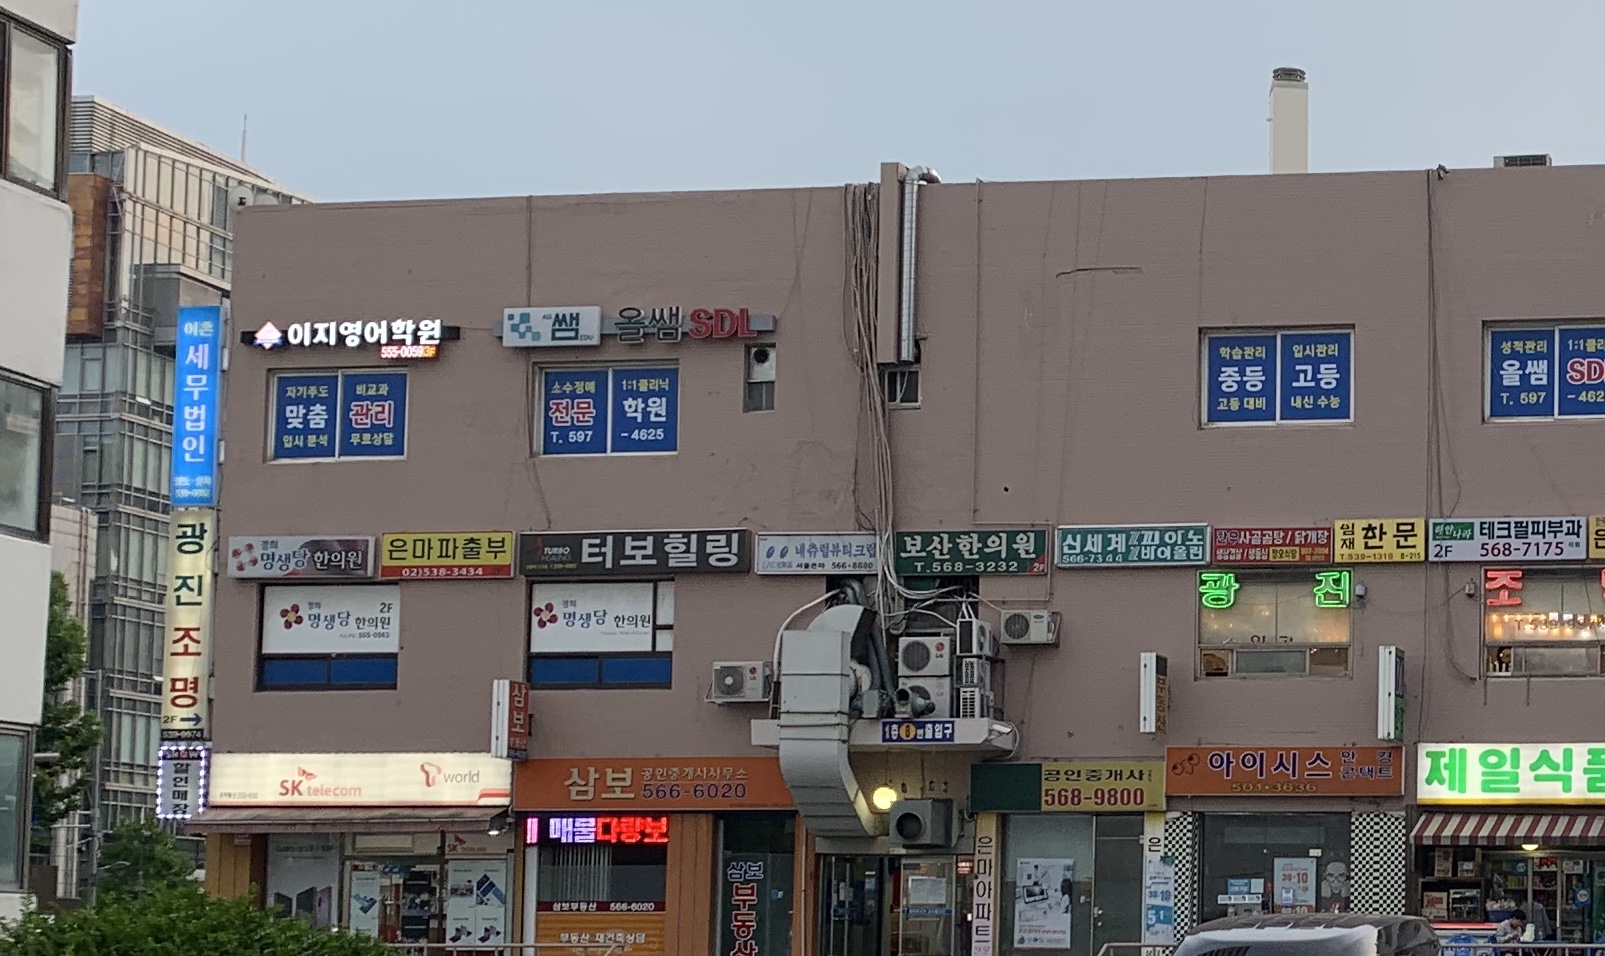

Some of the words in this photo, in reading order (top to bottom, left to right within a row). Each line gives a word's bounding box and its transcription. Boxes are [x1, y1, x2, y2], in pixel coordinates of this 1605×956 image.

[551, 312, 579, 341] 쌤
[613, 306, 682, 344] 올쌤
[687, 307, 757, 341] SDL
[287, 319, 442, 347] 이지영어학원
[381, 345, 423, 359] 555-0059
[1218, 346, 1267, 360] 학습관리
[1292, 343, 1339, 358] 입시관리
[1500, 339, 1548, 354] 성적관리
[1217, 365, 1267, 393] 중등
[1291, 363, 1341, 390] 고등
[1499, 359, 1549, 386] 올쌤
[285, 386, 329, 398] 자기주도
[355, 384, 389, 396] 비교과
[551, 381, 596, 394] 소수정예
[621, 378, 670, 392] 1:1클리닉
[181, 343, 210, 463] 세무법인
[1216, 398, 1241, 411] 고등
[1243, 397, 1267, 411] 대비
[1290, 395, 1315, 409] 내신
[1316, 394, 1341, 408] 수능
[1500, 393, 1514, 405] T.
[1520, 391, 1547, 405] 597
[284, 404, 329, 430] 맞춤
[349, 401, 394, 428] 관리
[548, 398, 597, 426] 전문
[622, 397, 668, 423] 학원
[283, 434, 304, 448] 입시
[307, 434, 329, 447] 분석
[349, 432, 394, 446] 무료상담
[550, 431, 563, 444] T.
[568, 431, 593, 443] 597
[1140, 530, 1204, 546] 피아노
[1361, 522, 1418, 551] 한문
[1479, 520, 1583, 540] 테크필피부과
[387, 537, 506, 560] 은마파출부
[544, 546, 570, 555] TURBO
[581, 533, 739, 569] 터보힐링
[899, 532, 1038, 560] 보산한의원
[1062, 532, 1126, 555] 신세계
[1433, 544, 1453, 559] 2F
[1480, 541, 1564, 558] 568-7175
[260, 549, 310, 571] 명생당
[313, 550, 363, 569] 한의원
[1062, 554, 1124, 564] 566-7344
[1140, 546, 1203, 561] 바이올린
[402, 567, 484, 577] 02)538-3434
[913, 561, 1018, 574] T.568-3232
[1033, 563, 1046, 573] 2F
[1313, 571, 1351, 609] 진
[1485, 570, 1523, 607] 조
[169, 522, 208, 709] 광진조명
[379, 602, 393, 613] 2F
[308, 611, 351, 630] 명생당
[355, 616, 390, 630] 한의원
[563, 609, 607, 629] 명생당
[614, 614, 651, 629] 한의원
[512, 684, 527, 733] 삼보
[162, 715, 178, 724] 2F
[641, 766, 748, 781] 공인중개사사무소
[1208, 750, 1332, 780] 아이시스
[1339, 765, 1393, 781] 콘택트
[443, 770, 480, 785] world
[564, 766, 635, 801] 삼보
[1043, 769, 1145, 782] 공인중개사
[279, 780, 303, 796] SK
[307, 785, 362, 797] telecom
[641, 783, 747, 799] 566-6020
[1044, 787, 1144, 807] 568-9800
[1148, 837, 1161, 853] 은
[727, 862, 764, 881] 삼보
[975, 836, 993, 943] 은마아파트
[610, 902, 655, 911] 566-6020
